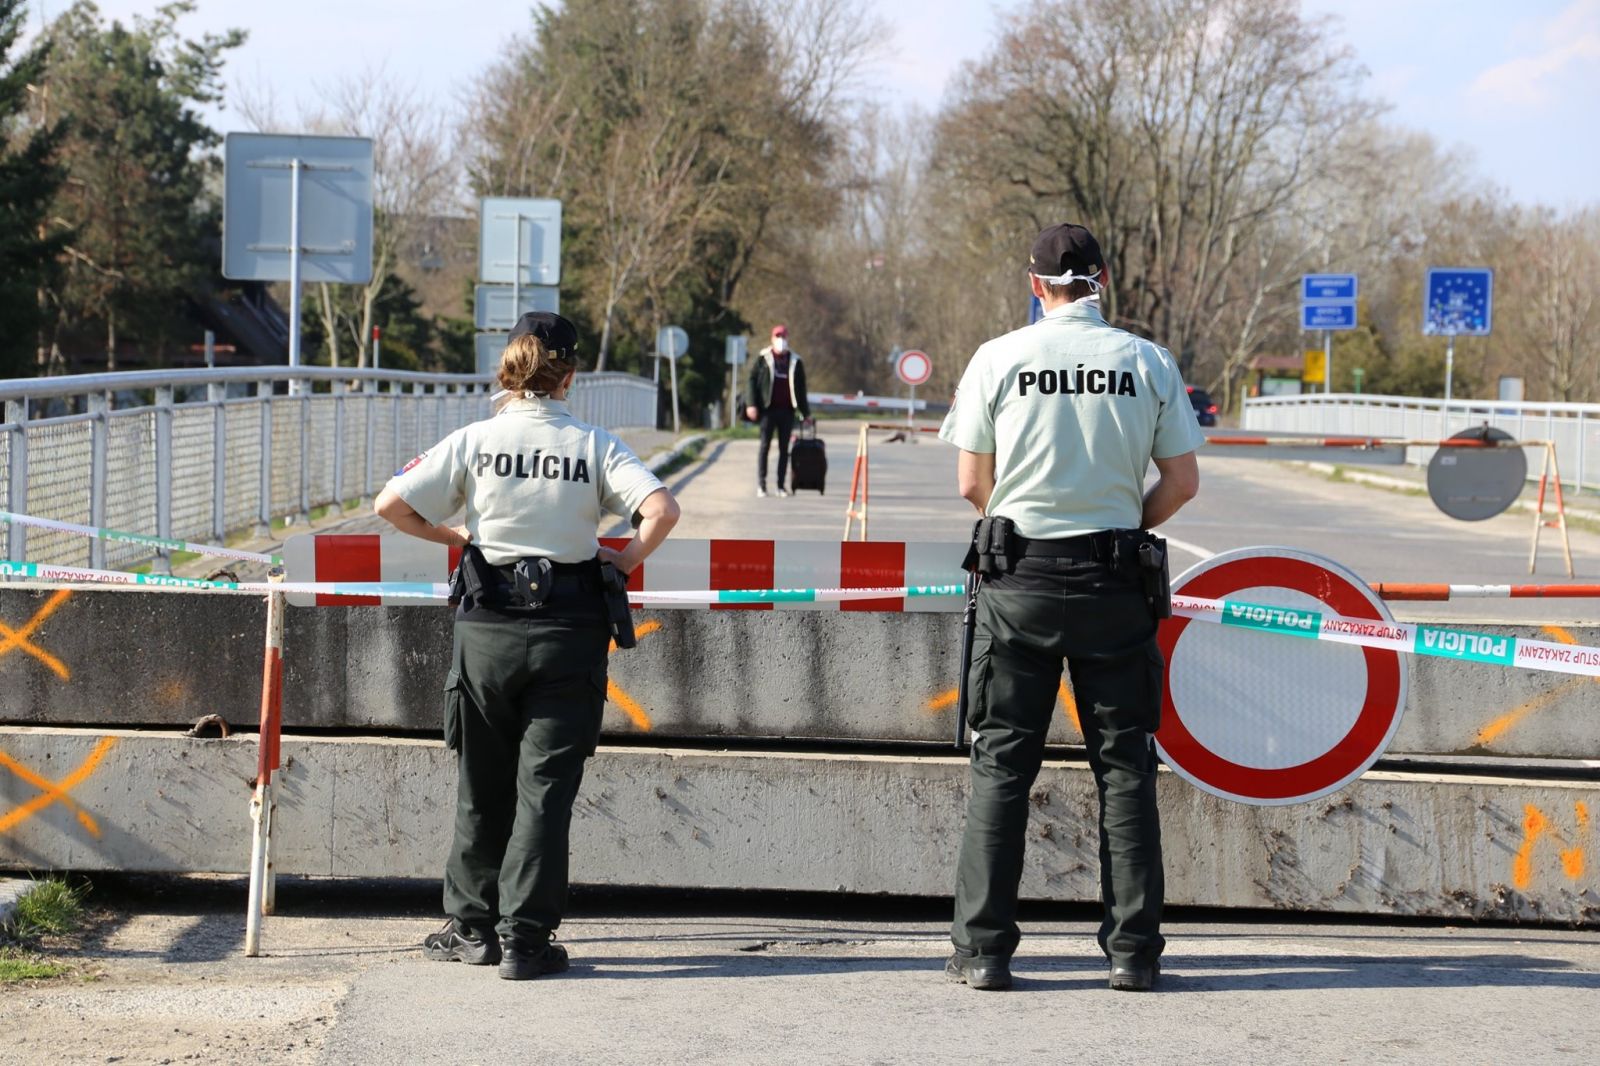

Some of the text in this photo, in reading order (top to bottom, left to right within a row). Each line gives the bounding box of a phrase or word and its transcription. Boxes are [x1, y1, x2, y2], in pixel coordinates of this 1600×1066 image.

[1018, 364, 1137, 397] POLÍCIA
[477, 449, 590, 483] POLÍCIA
[1230, 604, 1313, 630] POLÍCIA
[1323, 619, 1376, 637] ZAKÁZANÝ
[1377, 626, 1408, 641] VSTUP
[1423, 629, 1508, 657] POLÍCIA
[1518, 645, 1571, 663] ZAKÁZANÝ
